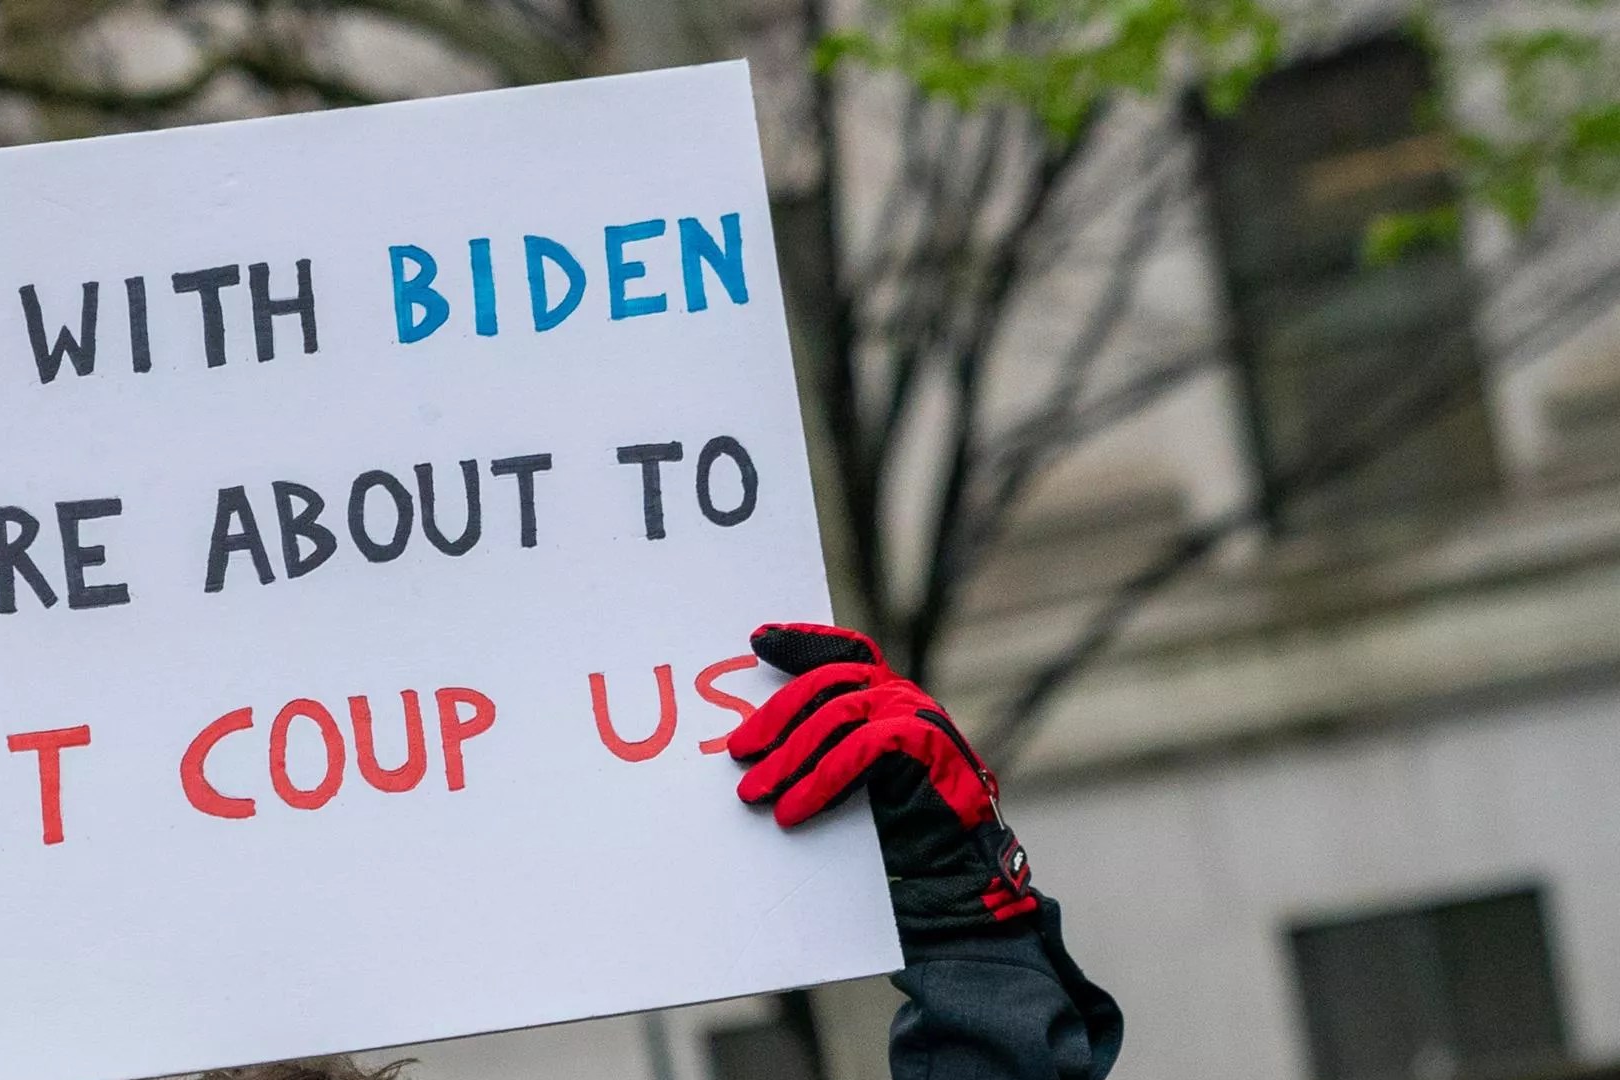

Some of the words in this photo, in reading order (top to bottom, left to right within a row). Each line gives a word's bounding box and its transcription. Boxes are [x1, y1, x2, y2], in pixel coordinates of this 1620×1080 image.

[18, 258, 319, 385] WITH
[387, 211, 750, 345] BIDEN
[203, 452, 553, 594] ABOUT
[616, 435, 759, 541] TO
[179, 687, 496, 820] COUP
[588, 654, 759, 763] US
